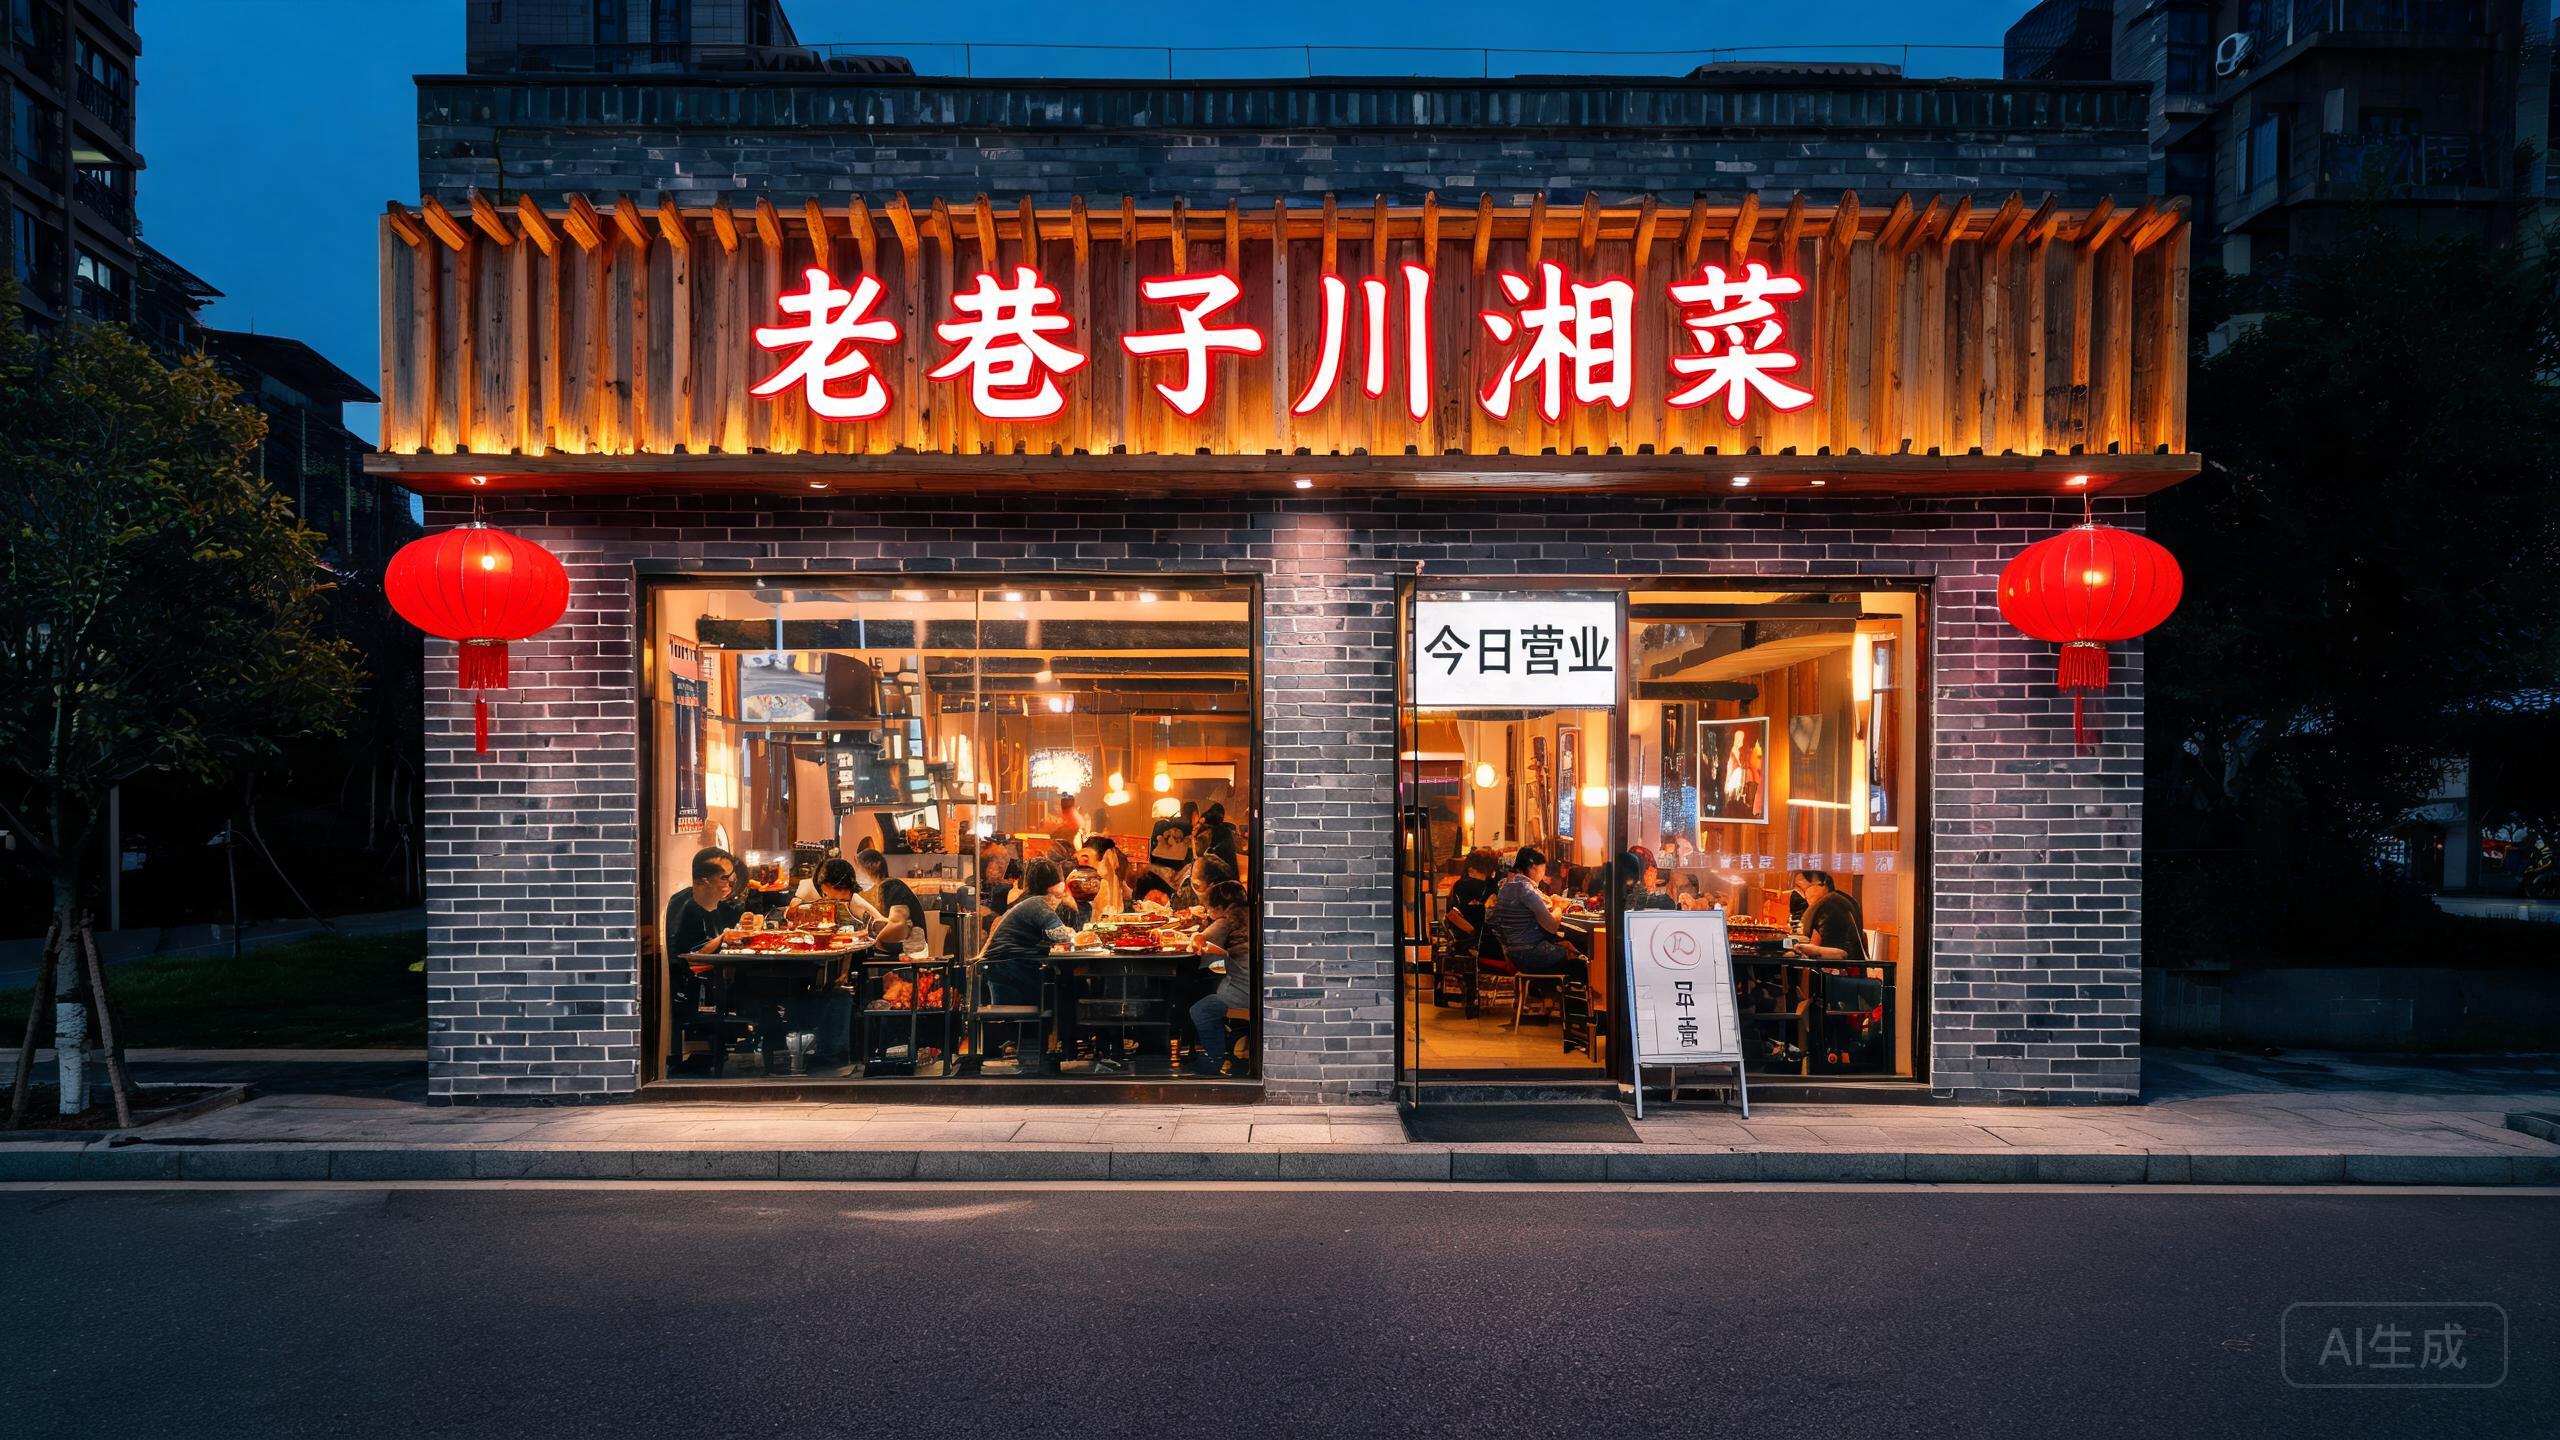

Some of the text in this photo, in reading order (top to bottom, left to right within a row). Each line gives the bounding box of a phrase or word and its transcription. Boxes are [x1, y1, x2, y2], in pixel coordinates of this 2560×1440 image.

[750, 262, 1815, 425] 老巷子川湘菜
[1424, 624, 1613, 676] 今日营业
